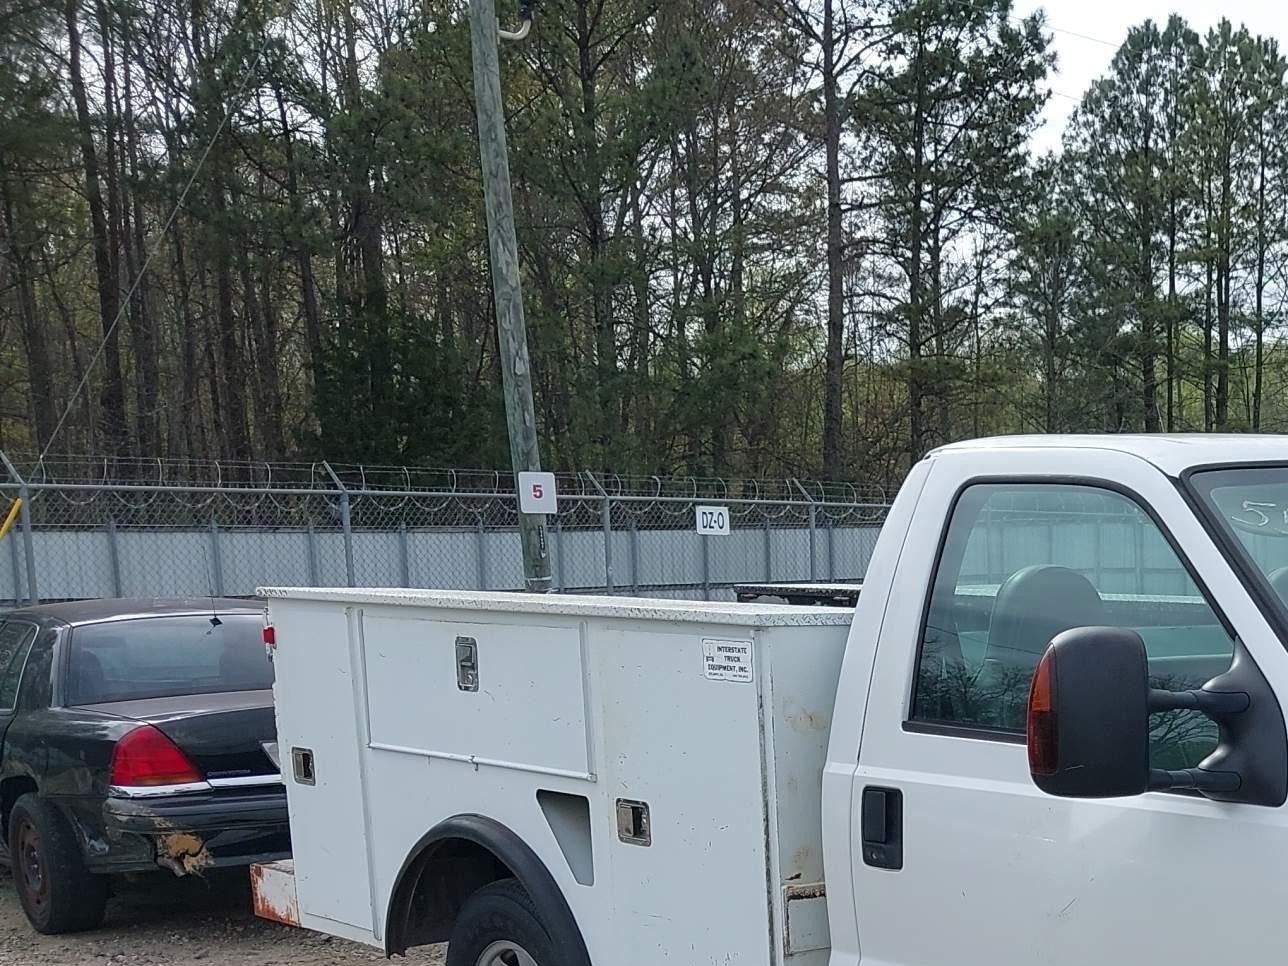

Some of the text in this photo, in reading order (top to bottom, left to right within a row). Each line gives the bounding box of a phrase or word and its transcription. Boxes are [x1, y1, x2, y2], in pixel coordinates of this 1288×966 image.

[532, 484, 544, 499] 5
[717, 646, 747, 654] INTERSTATE
[724, 655, 741, 663] TRUCK
[708, 664, 738, 673] EQUIPMENT,
